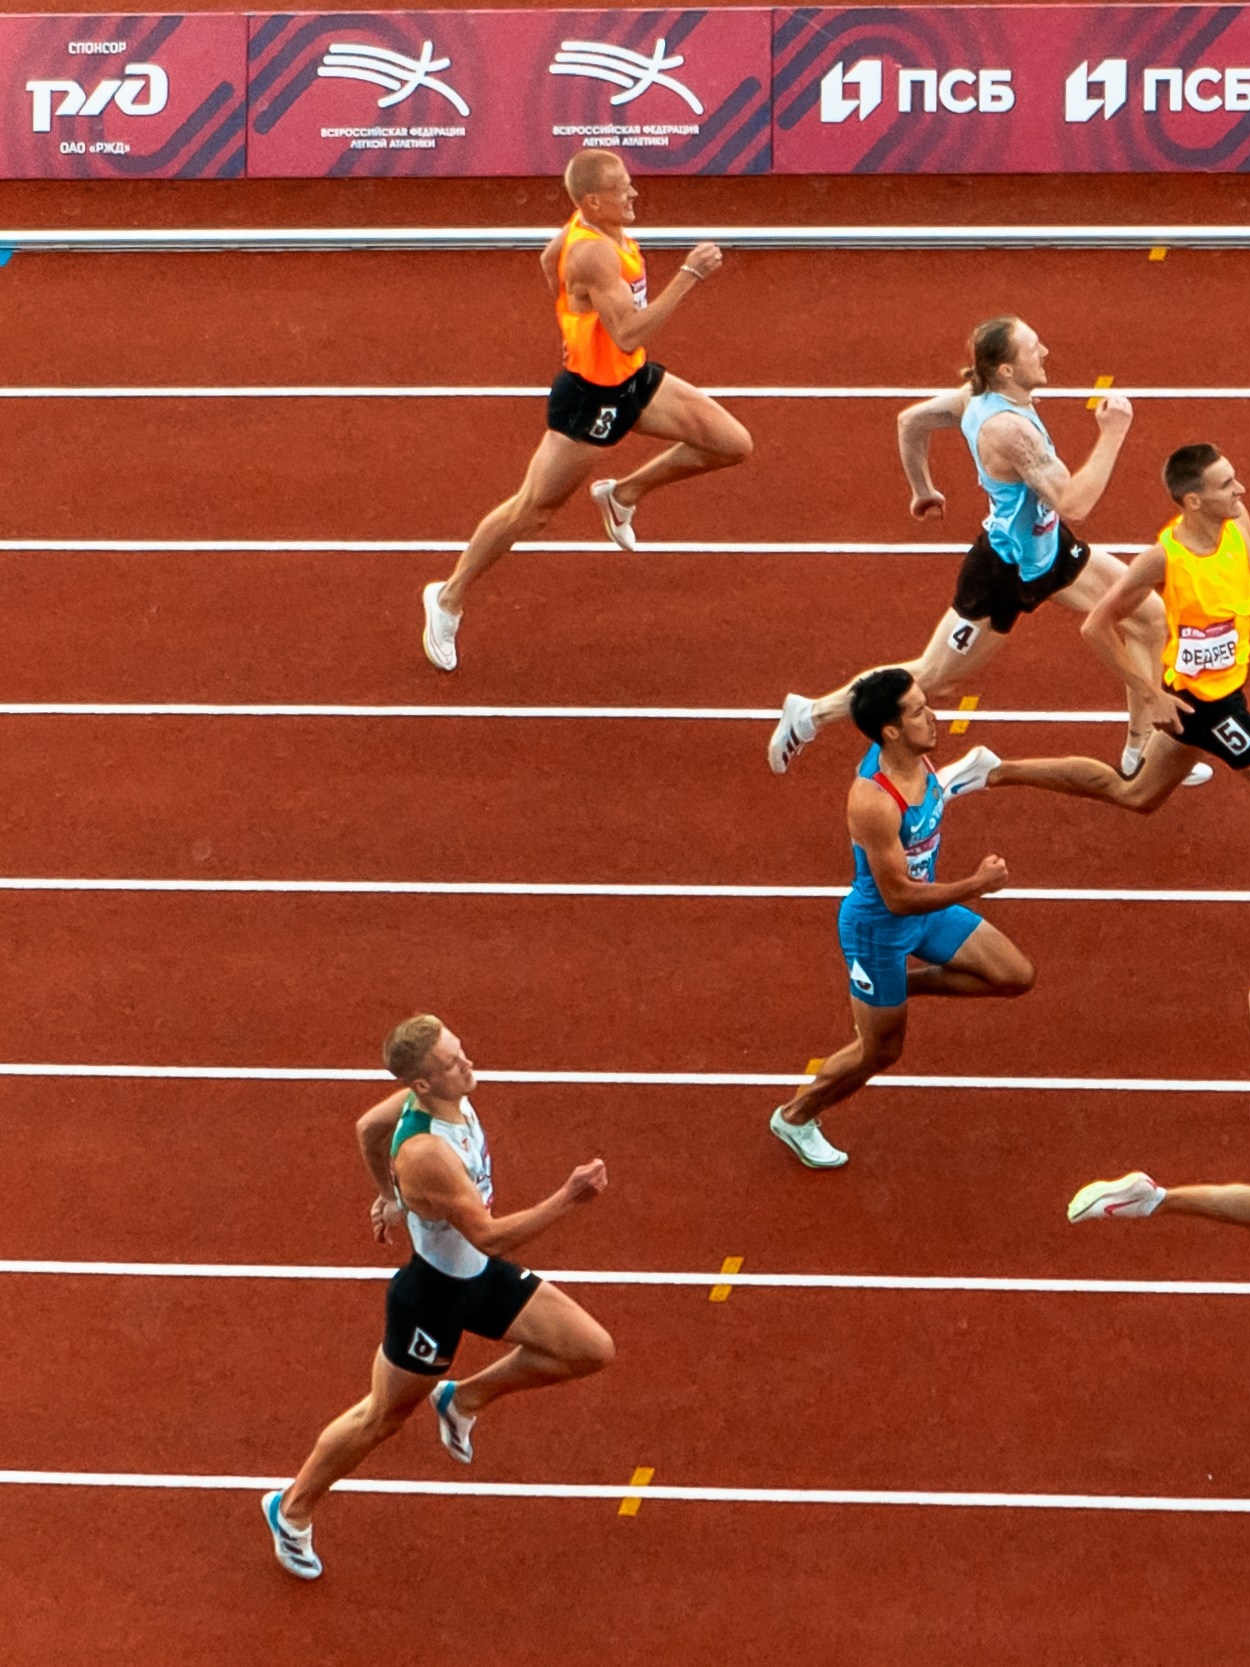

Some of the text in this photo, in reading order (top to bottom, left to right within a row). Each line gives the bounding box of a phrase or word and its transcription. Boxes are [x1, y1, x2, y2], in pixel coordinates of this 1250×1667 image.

[69, 41, 127, 54] СПОНСОР
[898, 69, 1016, 114] ПСБ
[320, 126, 466, 138] ВСЕРОССИЙСКАЯ ФЕДЕРАЦИЯ
[552, 124, 700, 136] ВСЕРОССИЙСКАЯ ФЕДЕРАЦИЯ
[60, 141, 86, 154] ОАО
[389, 139, 436, 149] АТЛЕТИКИ
[622, 136, 669, 147] АТЛЕТИКИ
[952, 624, 974, 651] 4
[1181, 640, 1236, 669] ФЕДЯЕВ
[1215, 721, 1248, 752] 5
